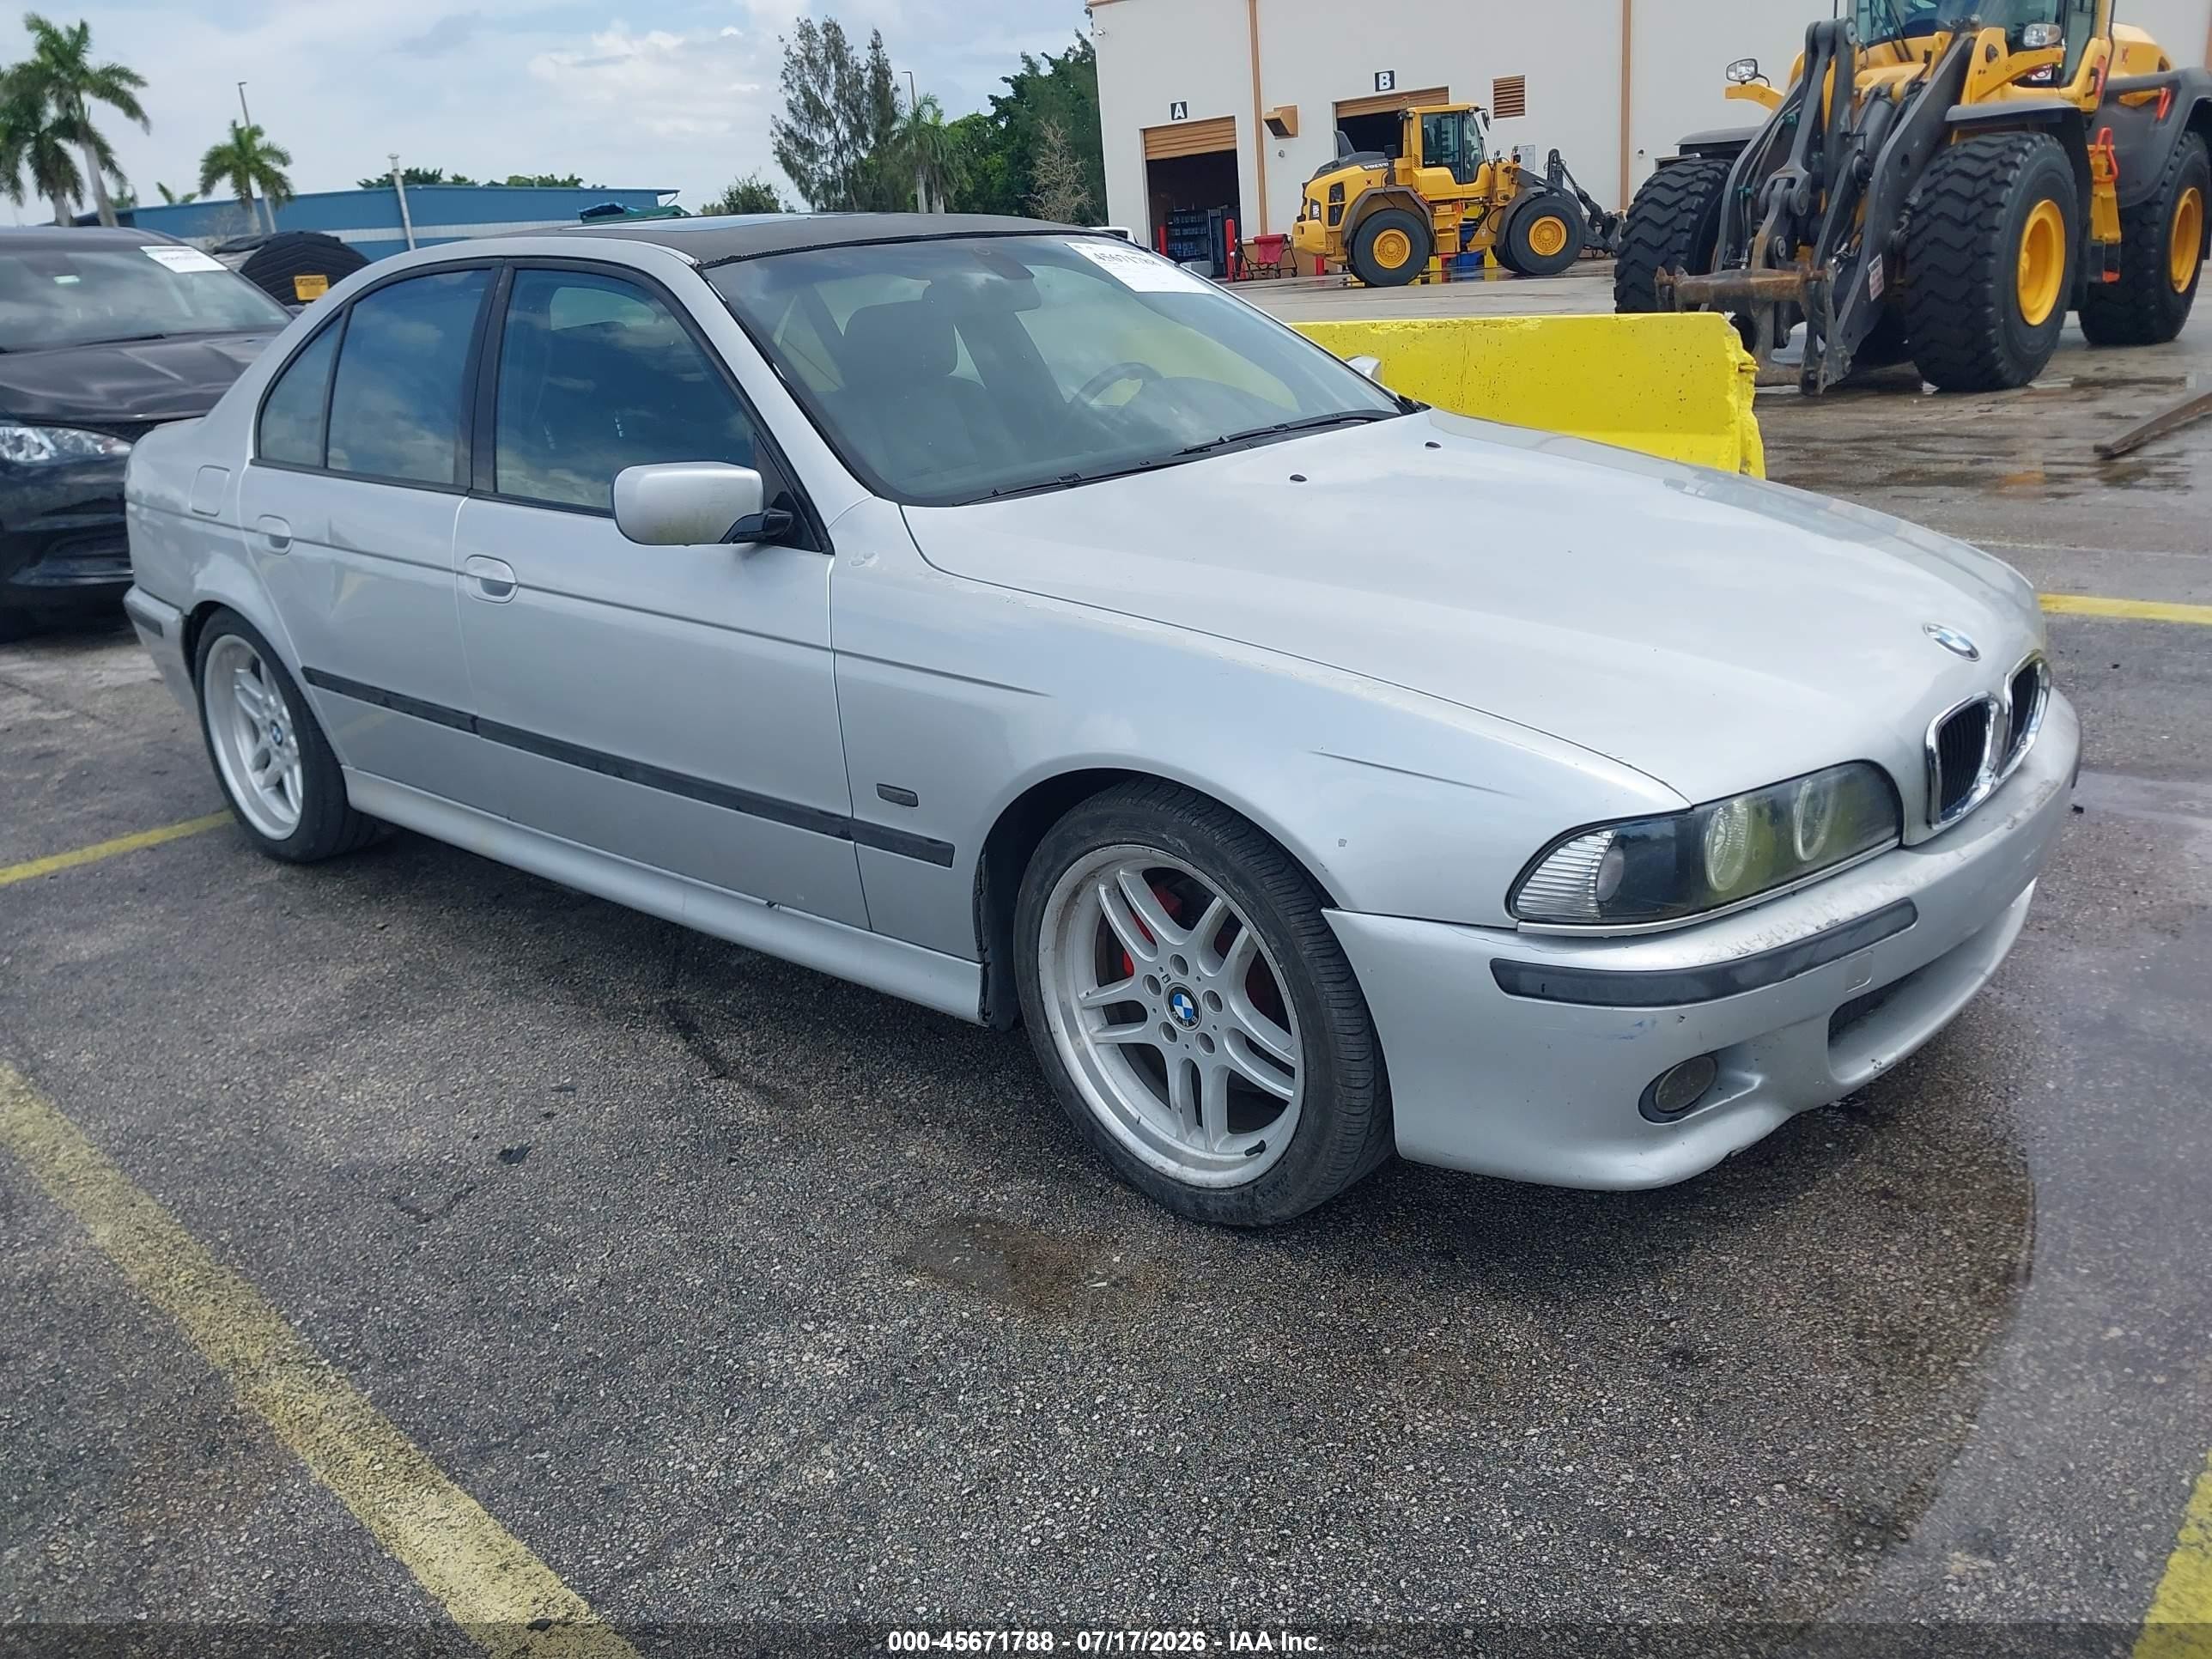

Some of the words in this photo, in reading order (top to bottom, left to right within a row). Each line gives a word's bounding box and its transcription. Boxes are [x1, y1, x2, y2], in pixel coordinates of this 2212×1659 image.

[1378, 72, 1392, 90] B
[1173, 102, 1186, 119] A
[1363, 161, 1389, 170] VOLVO
